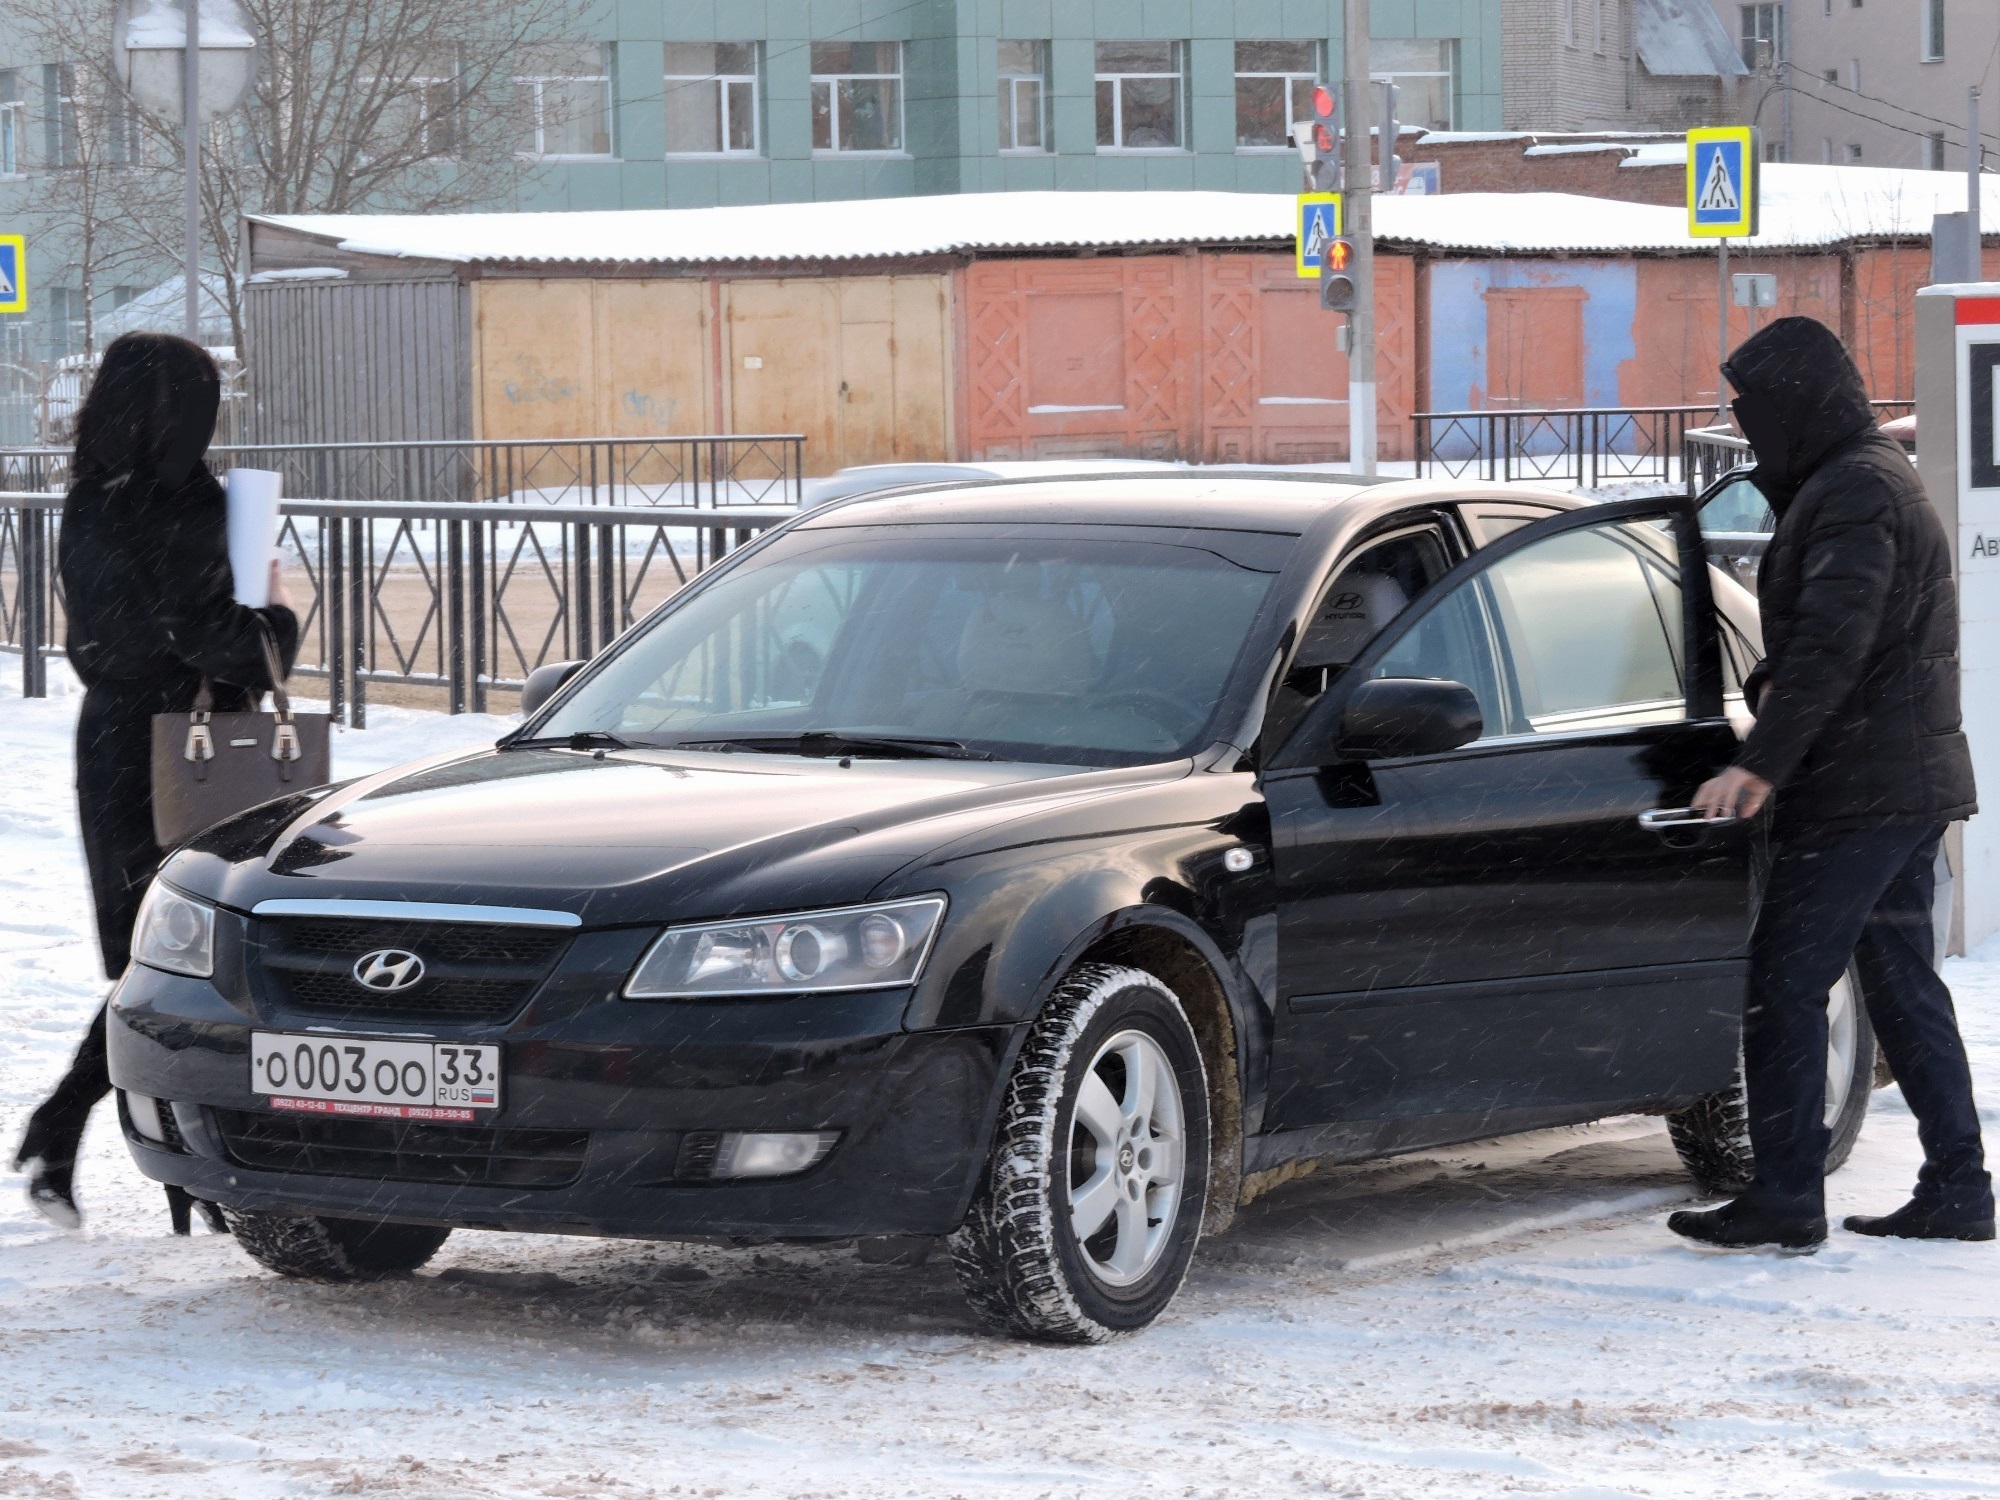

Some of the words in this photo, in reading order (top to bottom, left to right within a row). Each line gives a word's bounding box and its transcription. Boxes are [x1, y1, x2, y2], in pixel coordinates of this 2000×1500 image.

[440, 1048, 483, 1086] 33
[438, 1088, 470, 1101] RUS
[333, 1103, 373, 1113] ТЕХЦЕНТР
[373, 1106, 402, 1117] ГРАНД
